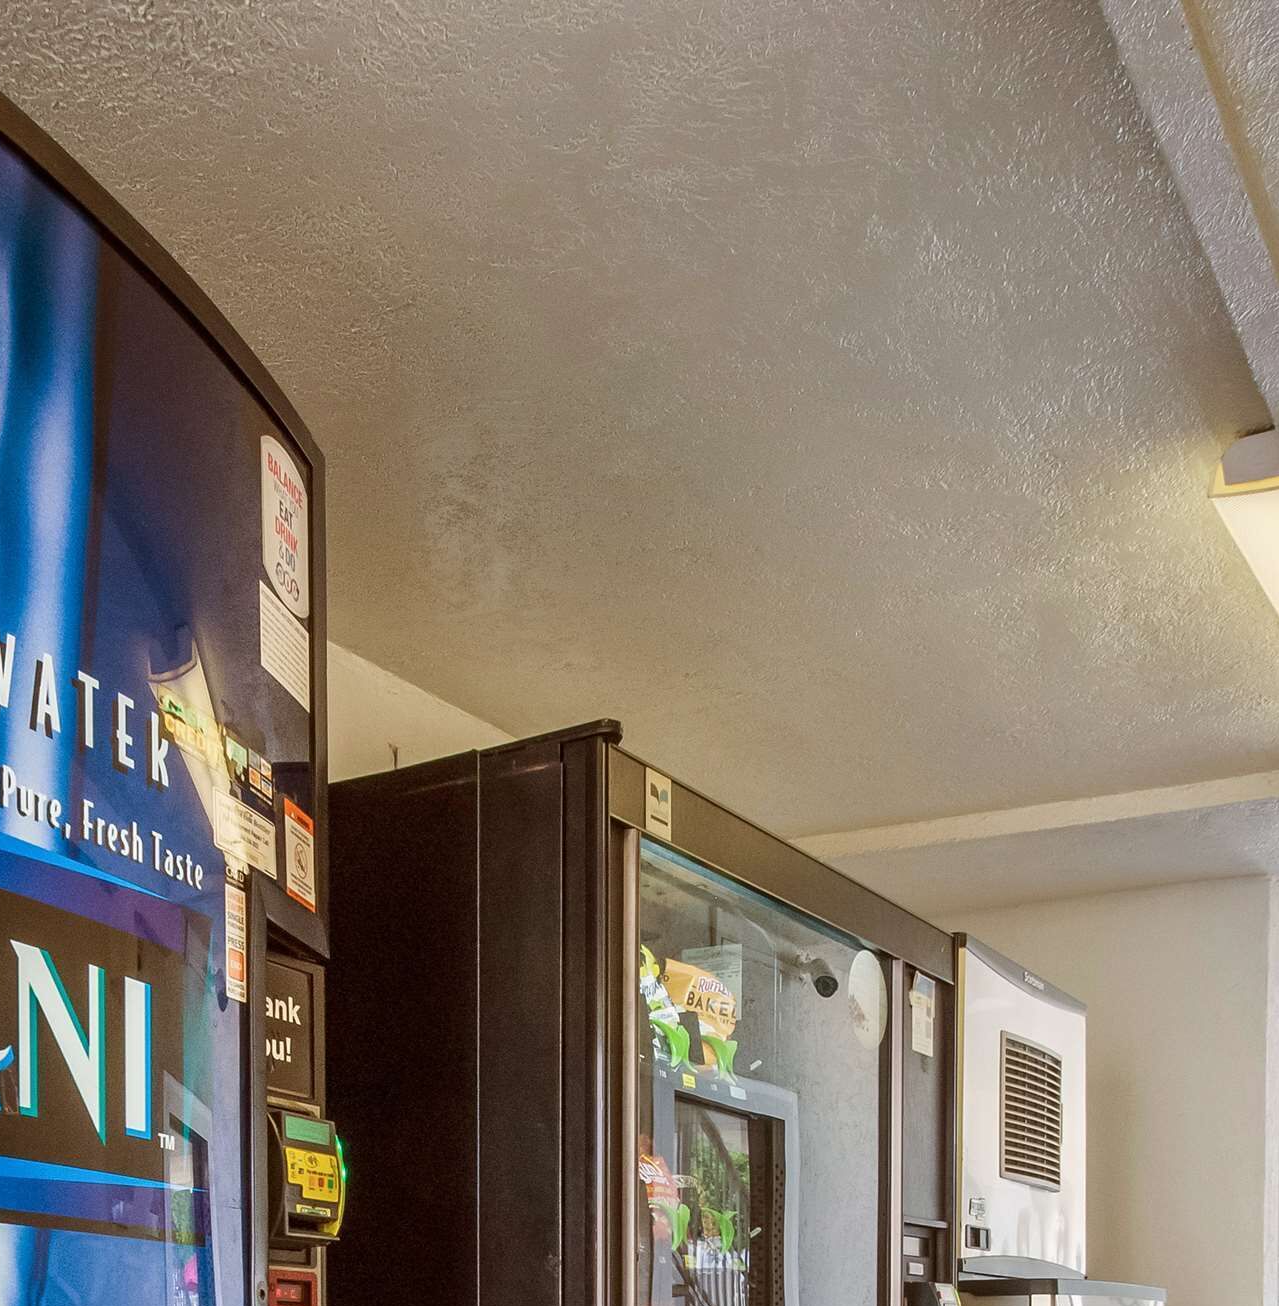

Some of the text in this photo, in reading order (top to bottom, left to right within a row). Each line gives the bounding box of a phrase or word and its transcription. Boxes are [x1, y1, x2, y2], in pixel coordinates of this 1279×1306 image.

[267, 451, 304, 510] BALANCE
[279, 499, 294, 531] EAT
[275, 514, 299, 554] DRINK
[285, 547, 296, 572] DO
[1, 764, 72, 840] Pure,
[81, 798, 144, 864] Fresh
[151, 830, 205, 891] Taste
[265, 995, 302, 1026] ank
